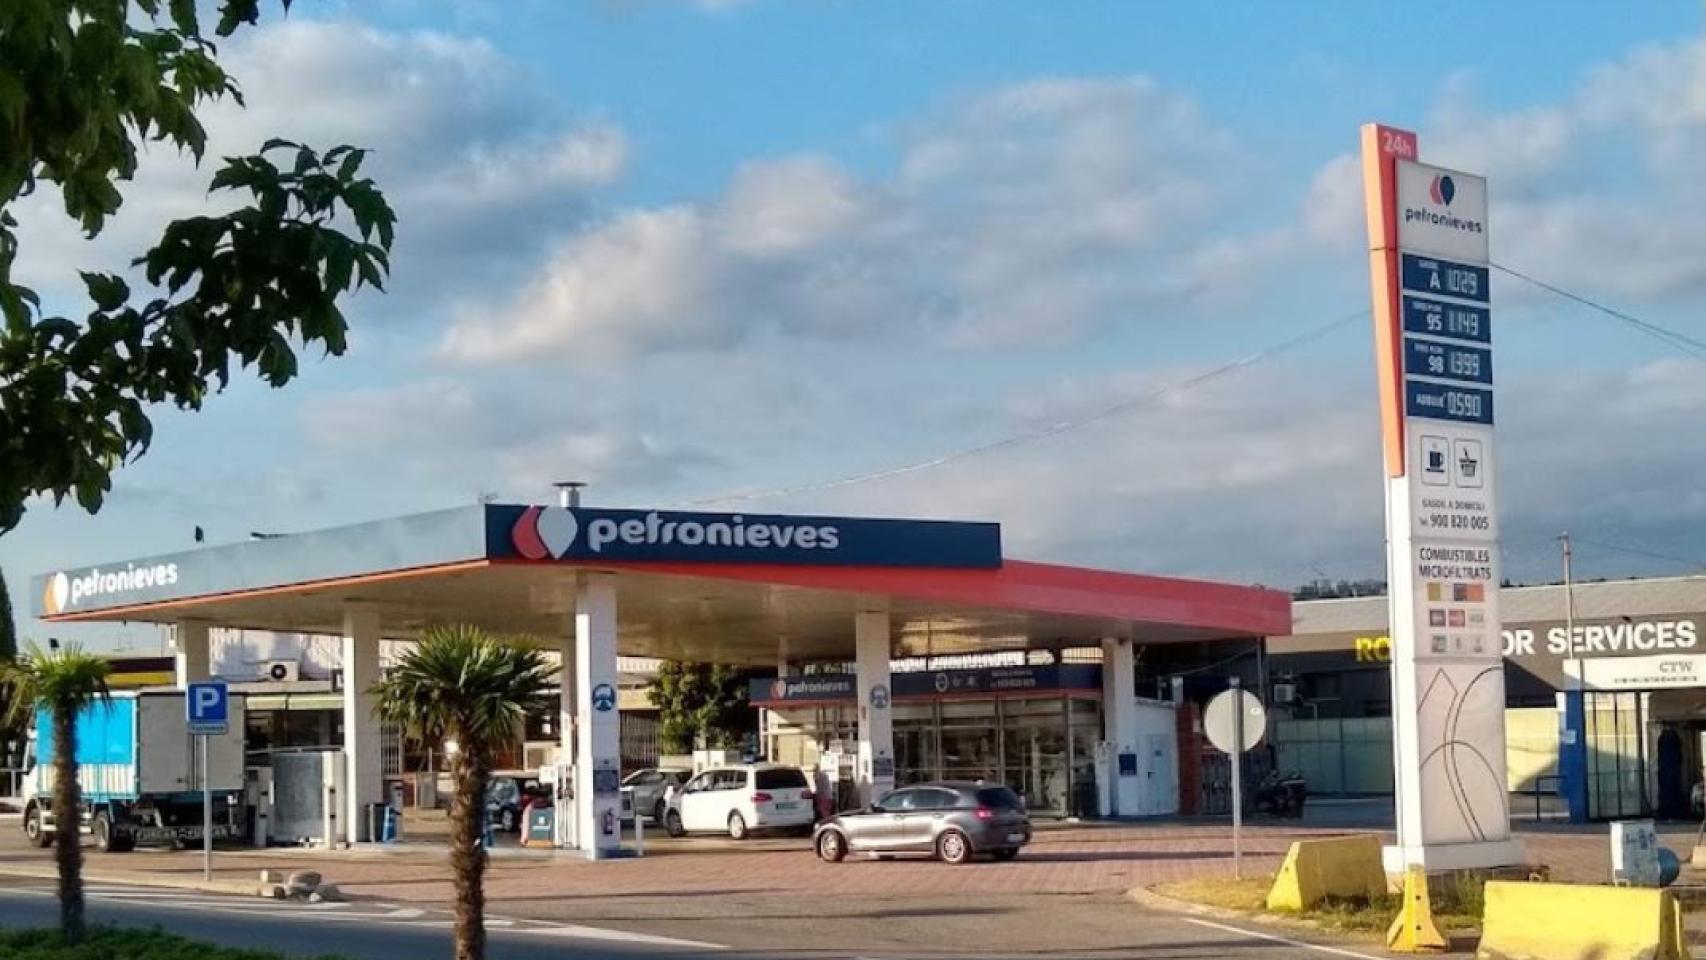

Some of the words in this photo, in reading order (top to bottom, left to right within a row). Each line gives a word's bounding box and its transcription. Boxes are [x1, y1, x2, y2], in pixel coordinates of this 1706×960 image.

[1383, 132, 1412, 156] 24h
[1405, 207, 1482, 233] petronieves
[1430, 272, 1440, 289] A
[1427, 313, 1442, 331] 95
[587, 509, 840, 552] petronieves
[1471, 516, 1489, 530] 005
[1419, 547, 1490, 563] COMBUSTIBLES
[71, 562, 178, 605] petronieves
[1418, 564, 1492, 580] MICROFILTRATS
[1547, 620, 1697, 652] SERVICES
[195, 687, 220, 717] P
